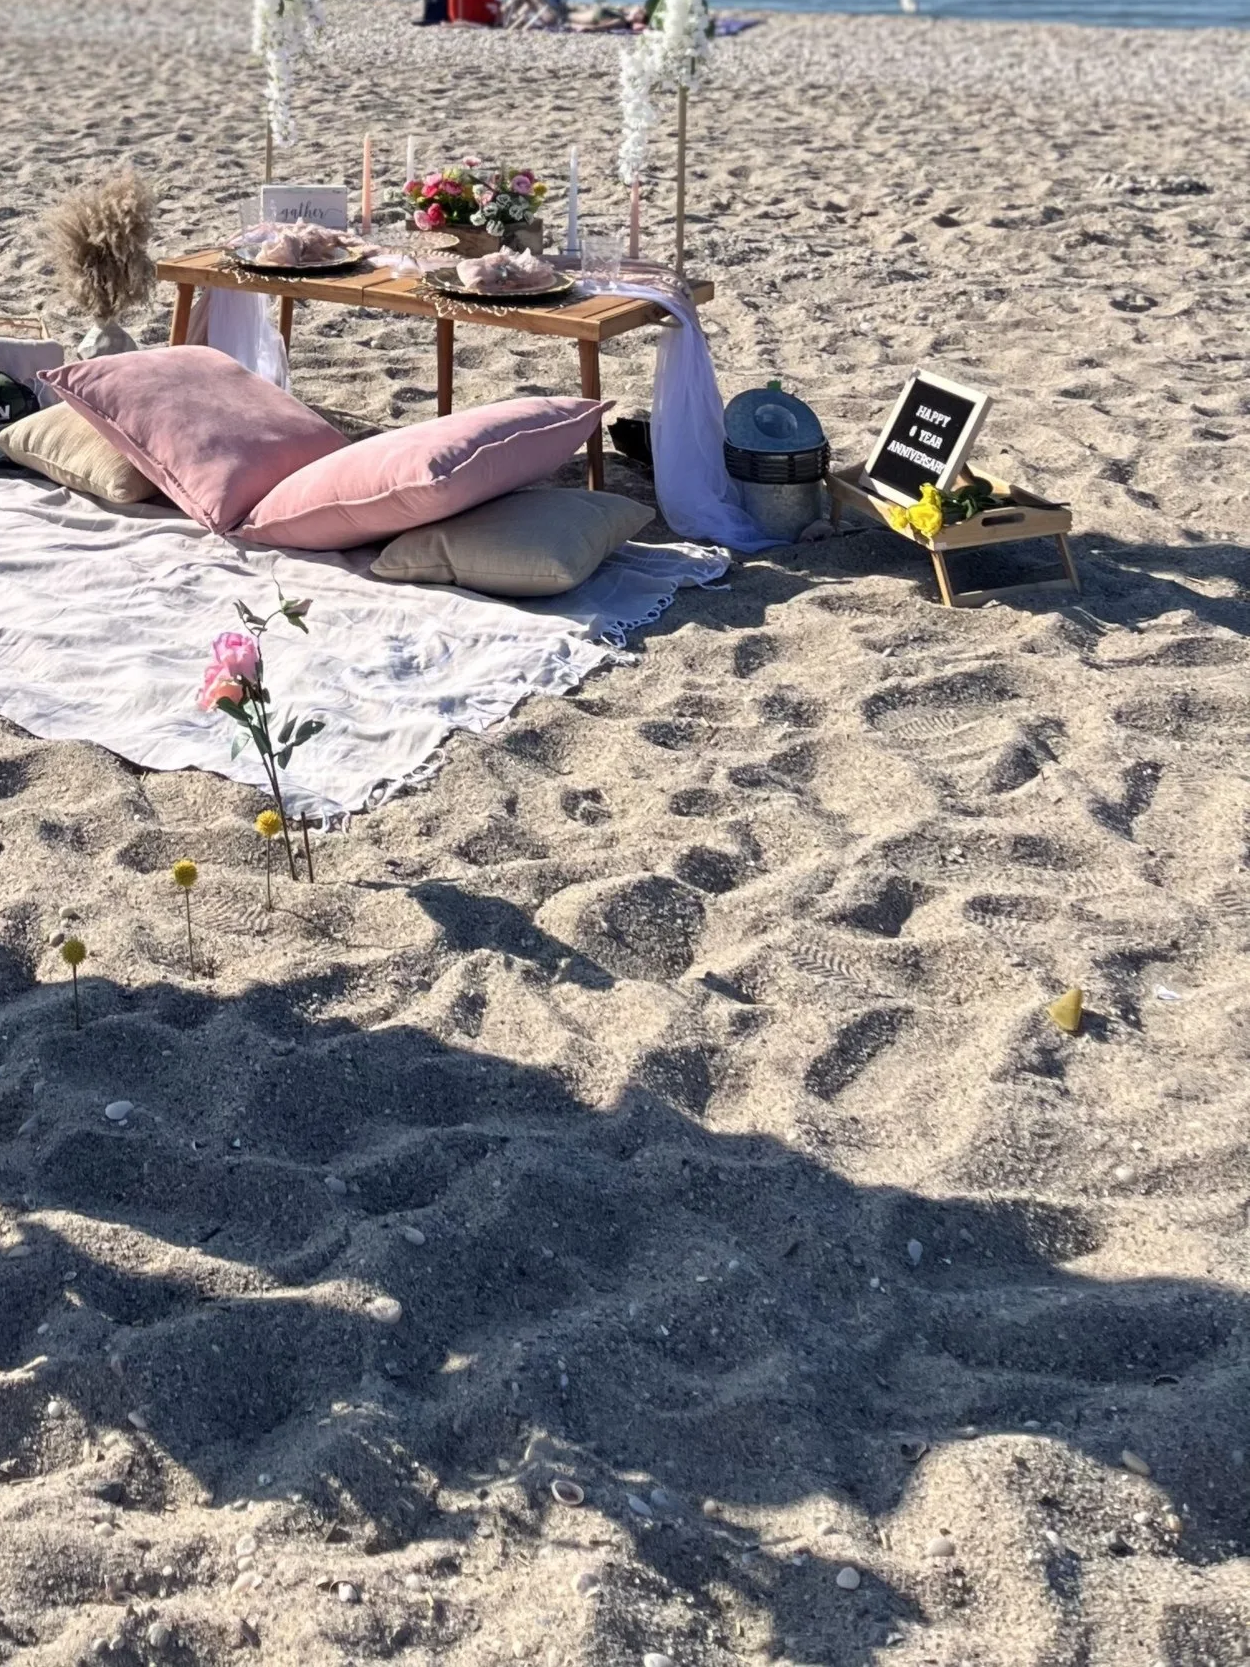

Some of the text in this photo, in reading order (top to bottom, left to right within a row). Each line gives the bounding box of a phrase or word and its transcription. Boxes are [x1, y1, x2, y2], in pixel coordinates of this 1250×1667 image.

[279, 201, 342, 222] gather
[916, 405, 951, 427] HAPPY
[918, 430, 943, 449] YEAR
